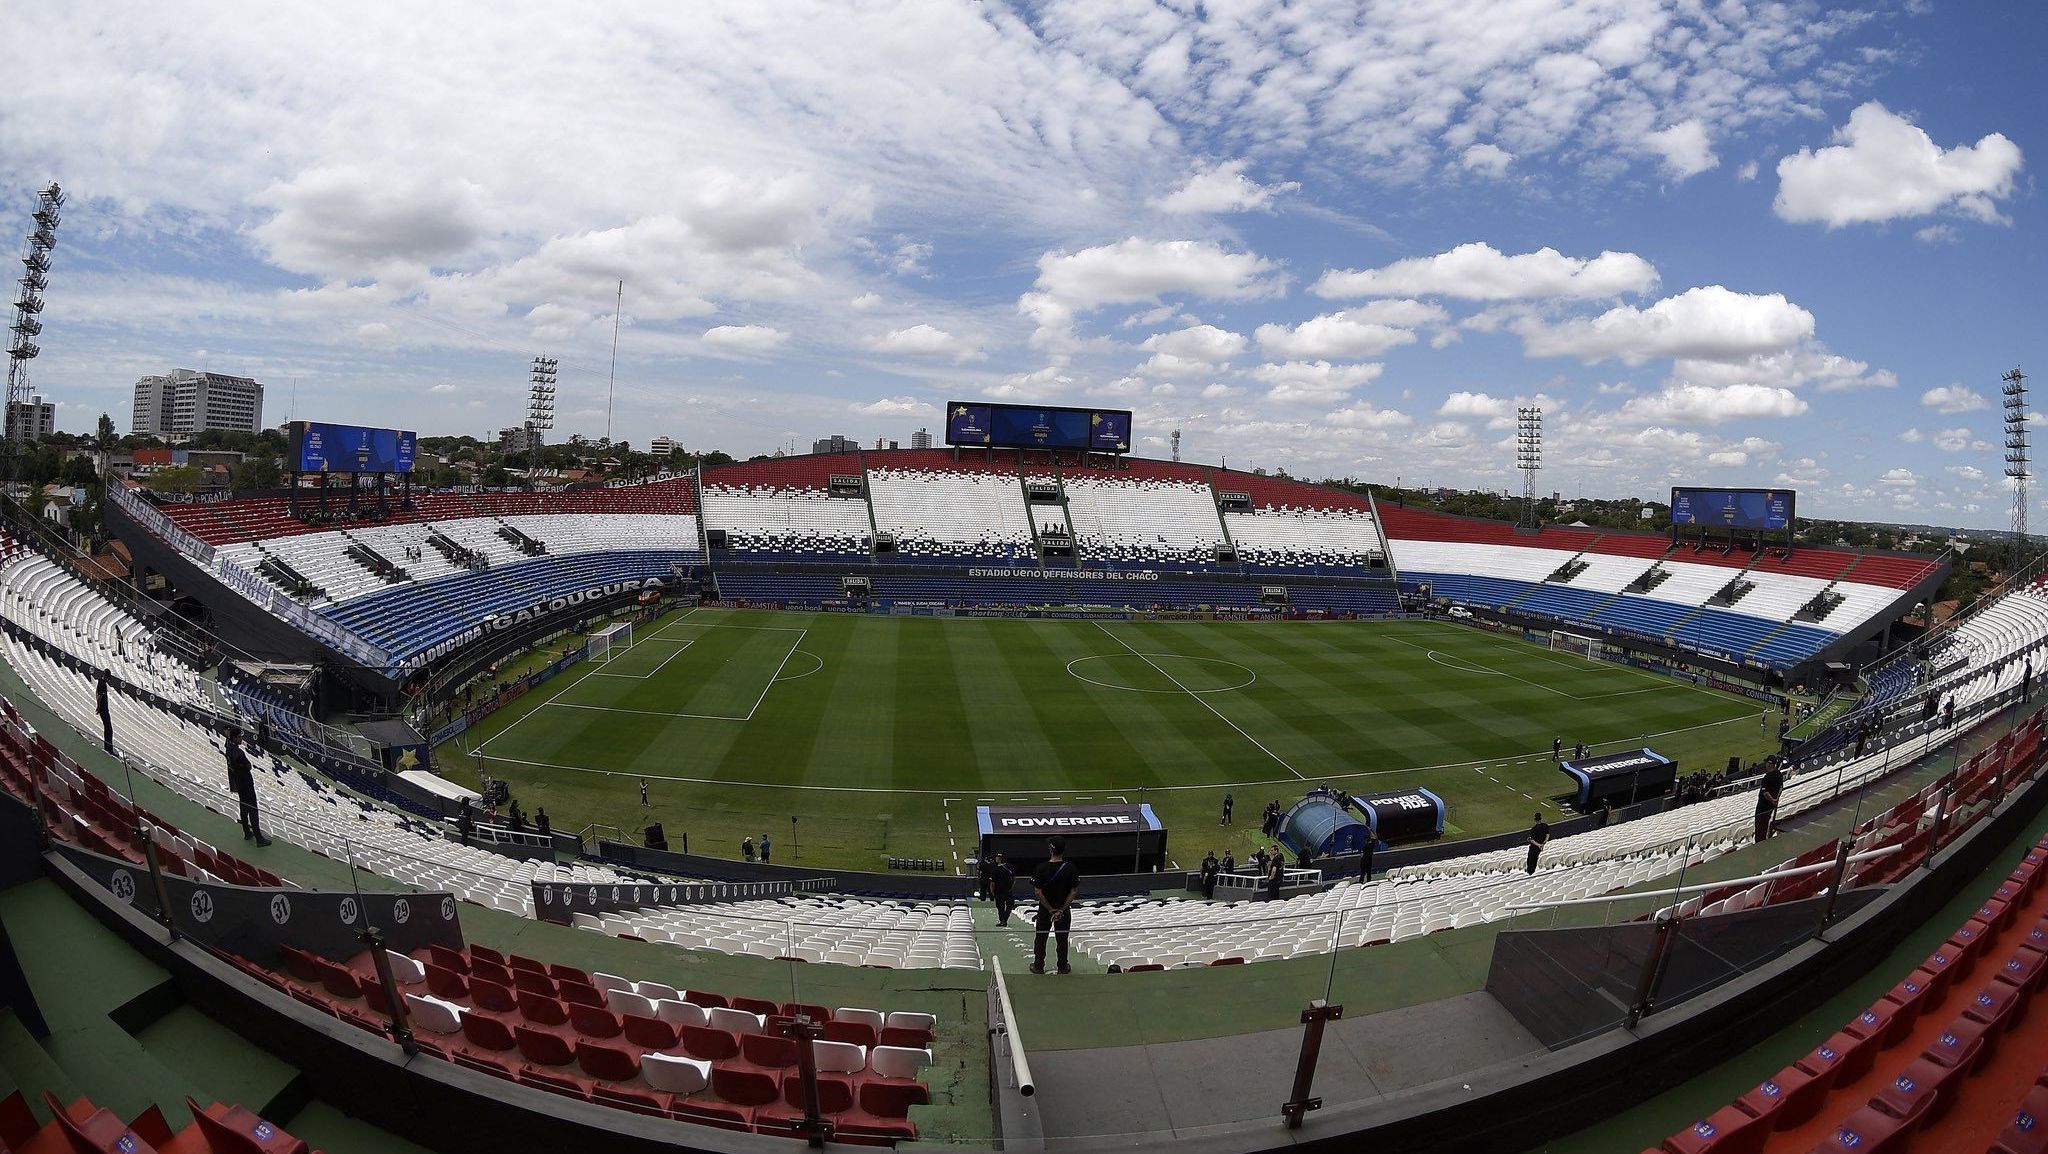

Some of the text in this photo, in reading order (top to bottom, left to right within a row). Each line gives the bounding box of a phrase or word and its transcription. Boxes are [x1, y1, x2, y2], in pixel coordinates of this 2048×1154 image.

[968, 568, 1010, 578] ESTADIO
[1042, 570, 1104, 580] DEFENSORES
[1106, 572, 1124, 580] DEL
[1126, 572, 1159, 581] CHACO
[492, 577, 664, 631] GALOUCURA
[1746, 689, 1782, 704] CONMEBOL
[1370, 794, 1424, 806] POWER
[113, 875, 134, 898] 33
[192, 893, 212, 916] 32
[273, 894, 288, 920] 31
[342, 900, 355, 920] 30
[396, 901, 410, 921] 29
[442, 898, 454, 917] 28
